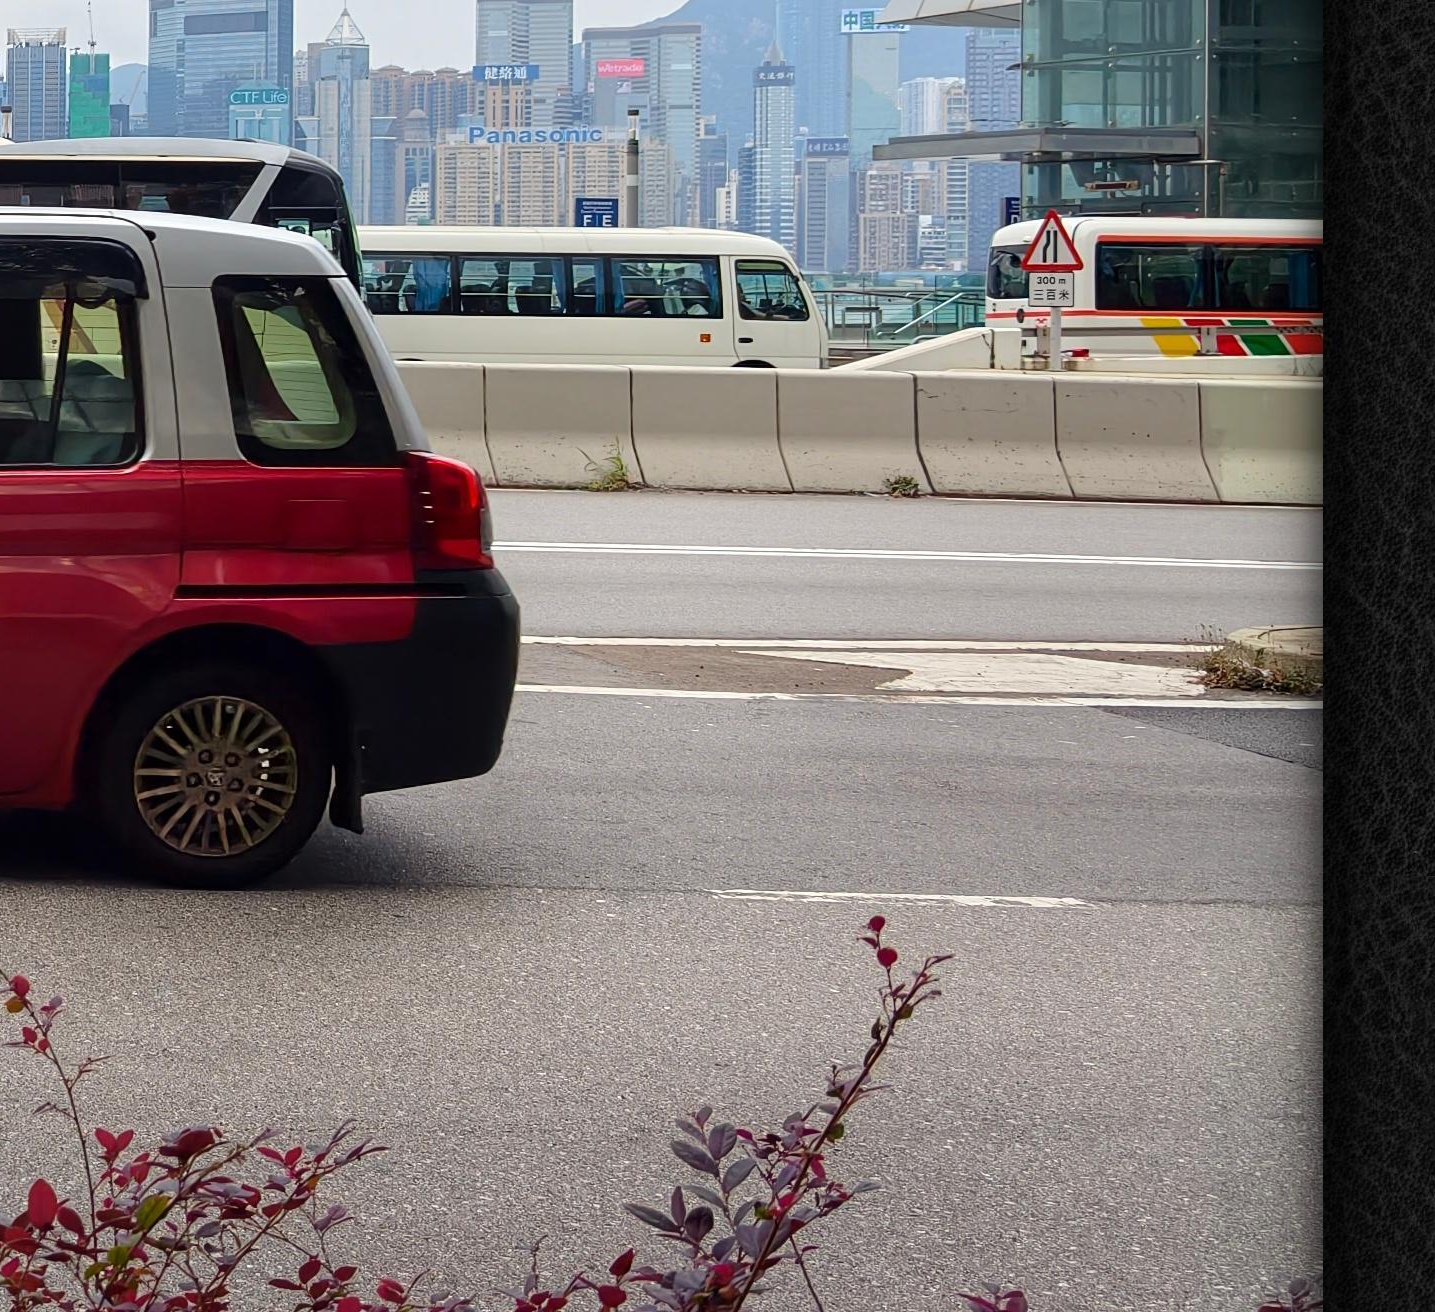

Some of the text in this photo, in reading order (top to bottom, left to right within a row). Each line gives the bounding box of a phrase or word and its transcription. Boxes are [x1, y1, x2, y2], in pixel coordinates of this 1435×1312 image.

[230, 90, 288, 104] CTF Life
[468, 125, 603, 144] Panasonic
[583, 214, 613, 227] F E
[1036, 276, 1066, 285] 300 m
[1033, 289, 1070, 301] 三百米
